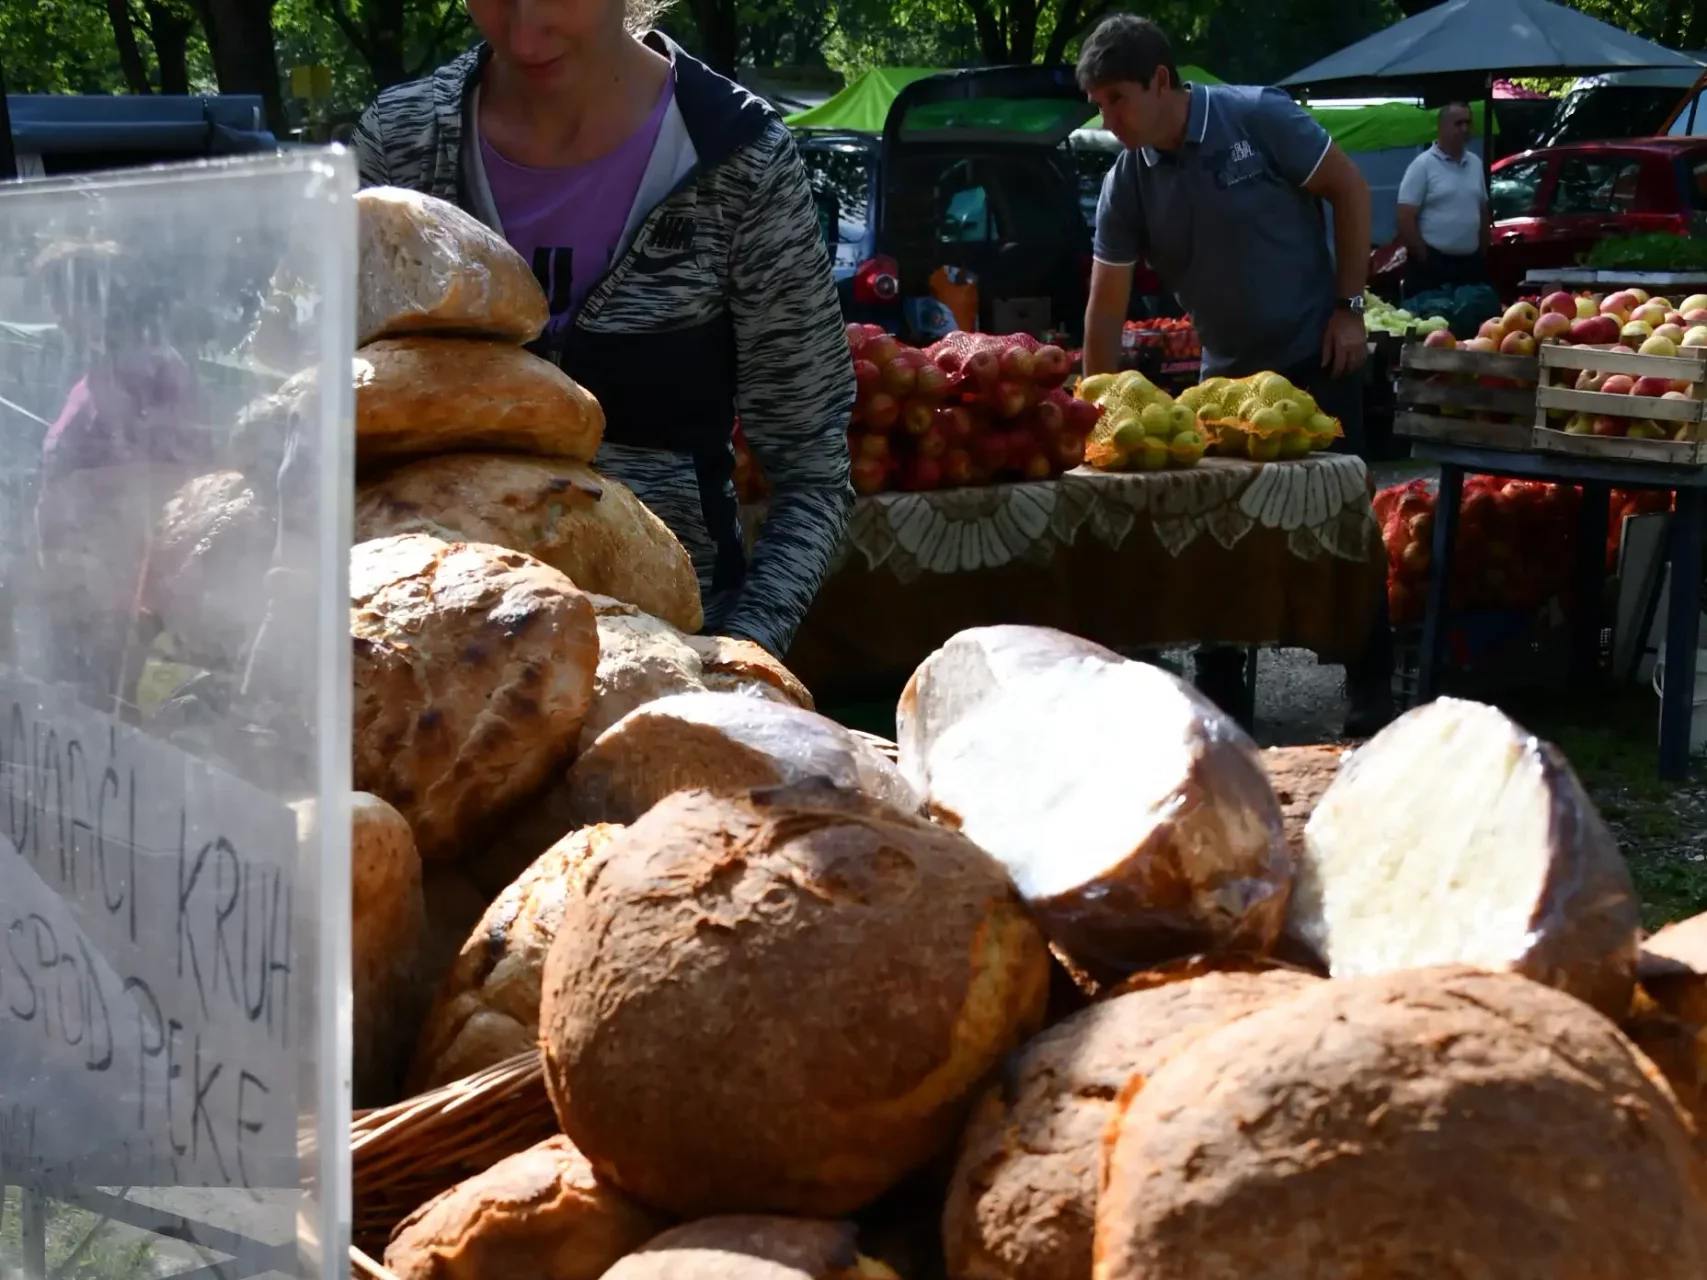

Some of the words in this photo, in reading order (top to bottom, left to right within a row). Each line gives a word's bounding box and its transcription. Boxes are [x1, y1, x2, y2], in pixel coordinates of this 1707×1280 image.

[0, 702, 137, 943] OMAĆI
[176, 806, 292, 1050] KRUH
[122, 975, 270, 1202] PEKE
